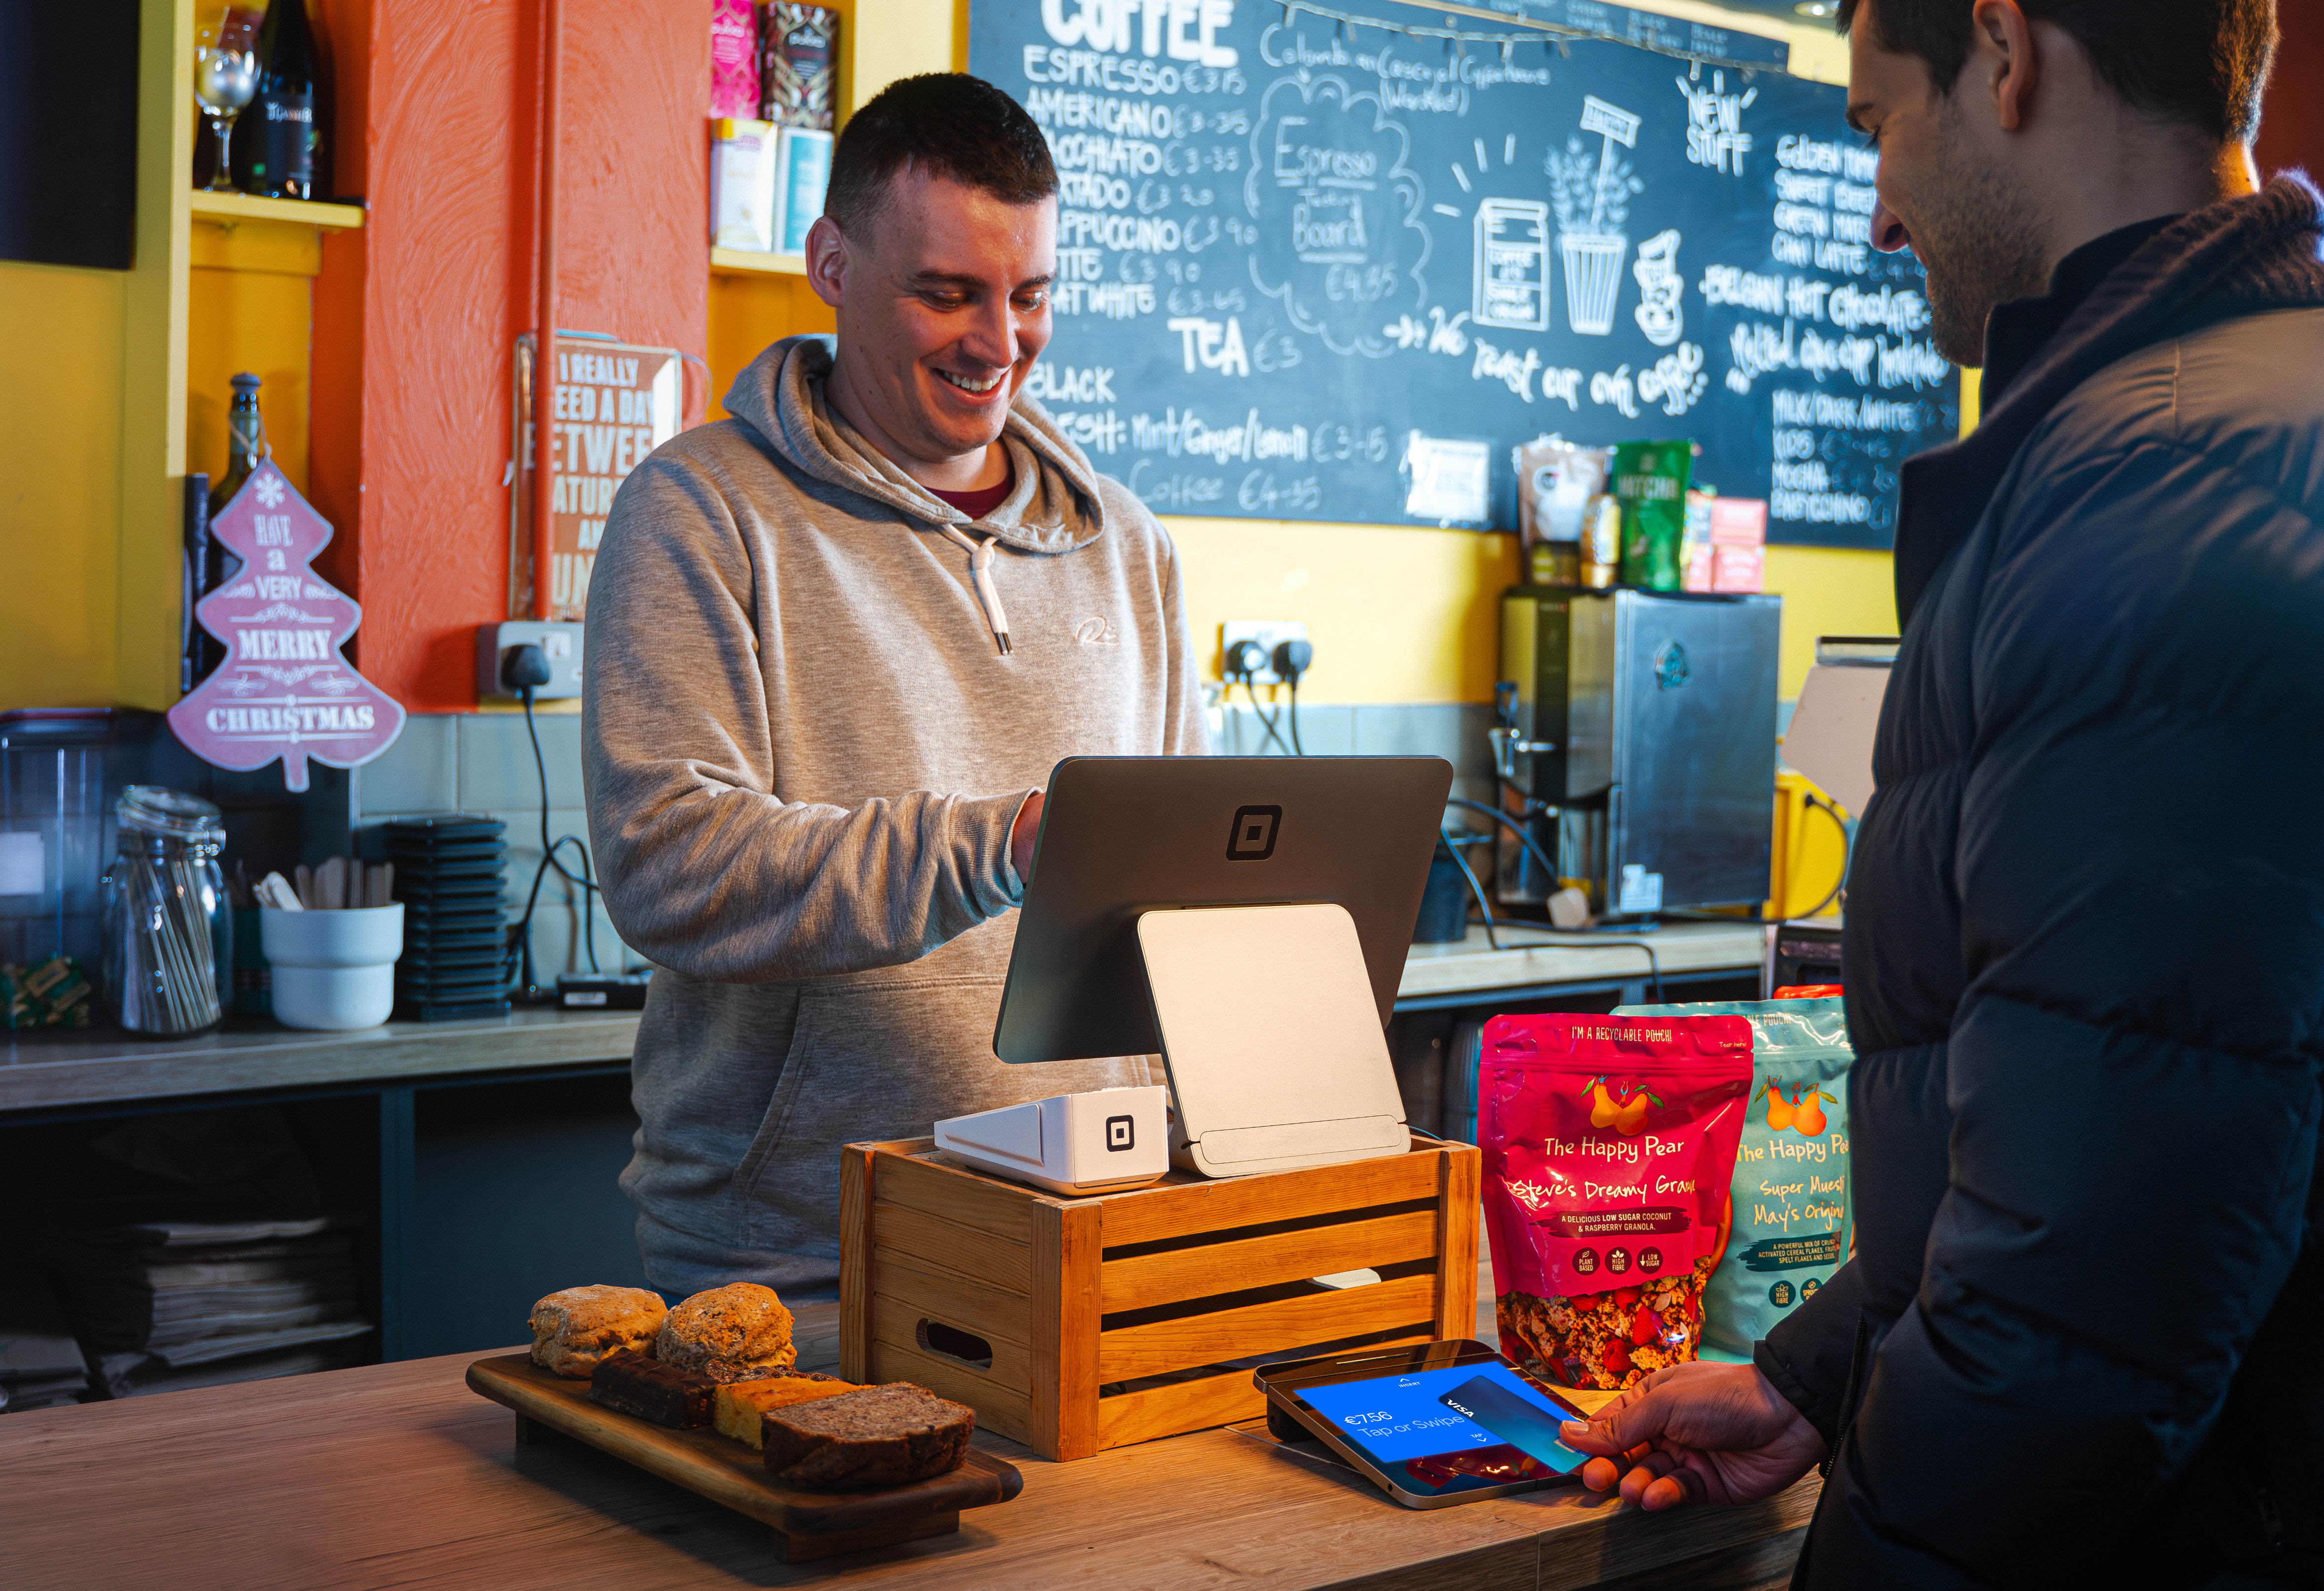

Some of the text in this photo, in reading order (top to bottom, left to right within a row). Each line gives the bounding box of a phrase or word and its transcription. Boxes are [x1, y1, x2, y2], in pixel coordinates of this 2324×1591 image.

[1041, 0, 1239, 68] COFFEE
[1023, 44, 1181, 94] ESPRESSO
[1026, 86, 1173, 139] AMERICANO
[1688, 86, 1741, 134] NEW
[1039, 123, 1163, 178] ACCHIATO
[1686, 124, 1753, 177] STUFF
[1059, 172, 1131, 210] RTADO
[1056, 248, 1103, 281] TTE
[1051, 281, 1086, 316] AT
[1167, 316, 1249, 378] TEA
[559, 353, 639, 388] I REALLY
[1025, 362, 1116, 403] BLACK
[554, 385, 596, 422] EED
[600, 388, 615, 423] A
[254, 515, 293, 547] HAVE
[267, 549, 286, 571] a
[254, 575, 302, 601] VERY
[236, 629, 331, 661] MERRY
[205, 705, 375, 733] CHRISTMAS
[1572, 1026, 1672, 1042] I'M A RECYCLABLE POUCH!
[1545, 1136, 1684, 1163] The Happy Pear
[1737, 1134, 1849, 1162] The Happy Pea
[1585, 1181, 1647, 1204] Dreamy
[1760, 1180, 1804, 1203] Super
[1585, 1224, 1622, 1232] RASPBERRY
[1754, 1201, 1843, 1232] May's Origin
[1344, 1411, 1393, 1425] €7.56
[1447, 1398, 1475, 1417] VISA
[1357, 1416, 1465, 1437] Tap or Swipe
